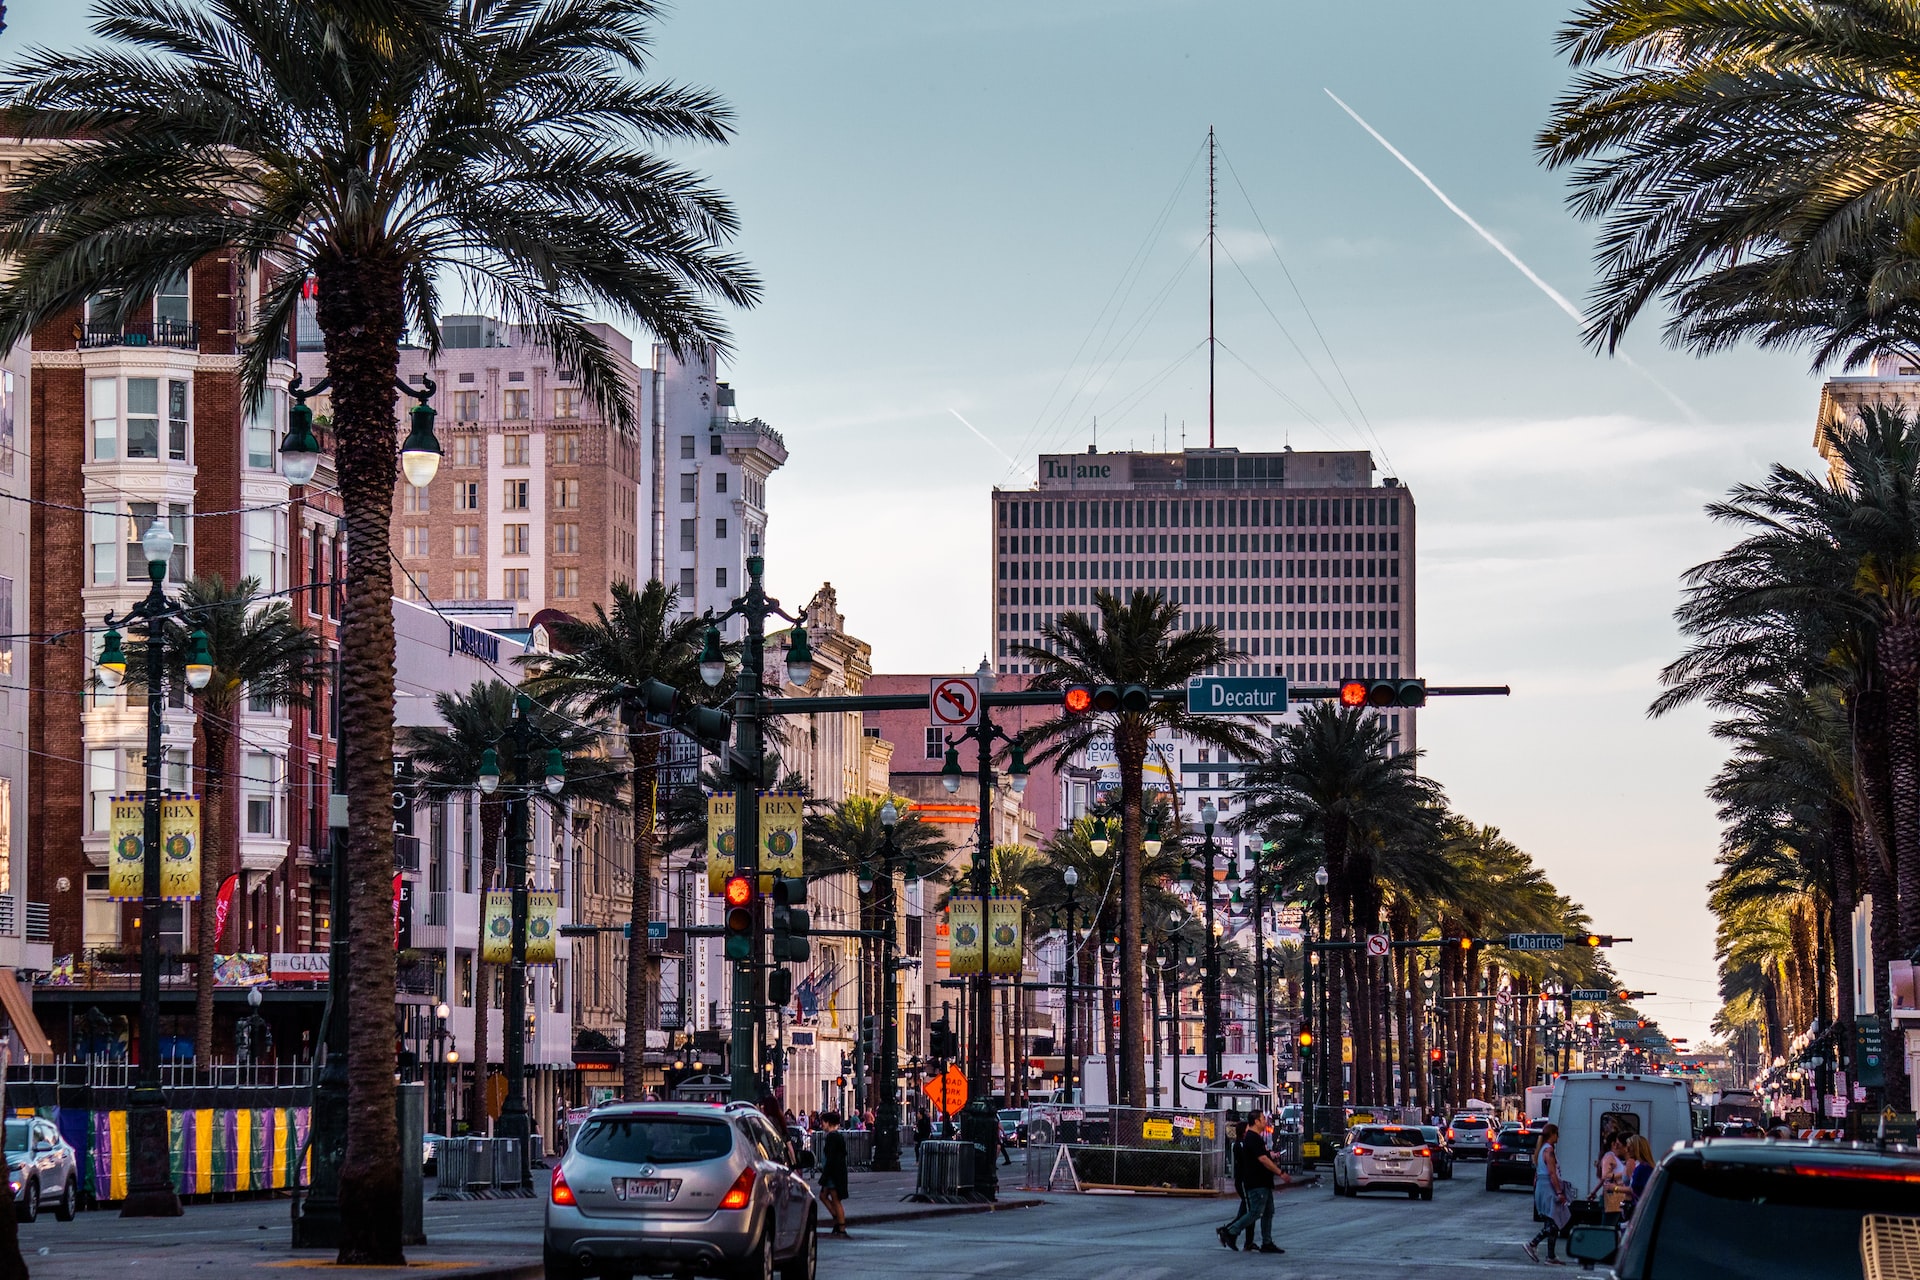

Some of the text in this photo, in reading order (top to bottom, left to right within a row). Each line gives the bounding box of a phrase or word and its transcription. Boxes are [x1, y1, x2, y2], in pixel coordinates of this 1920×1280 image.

[1043, 460, 1111, 478] Tuane
[1211, 684, 1277, 706] Decatur
[163, 805, 194, 818] REX
[714, 802, 735, 815] RE
[765, 801, 797, 815] REX
[1221, 836, 1234, 845] THE
[121, 874, 141, 887] 150
[169, 873, 189, 886] 150
[529, 896, 553, 906] REX
[953, 903, 978, 914] REX
[993, 903, 1017, 914] REX
[1517, 935, 1562, 949] Chartres
[274, 955, 330, 971] THE GIAN
[1579, 991, 1602, 1000] Royal
[1614, 1020, 1637, 1029] Bourbon
[945, 1078, 962, 1086] OAD
[940, 1088, 961, 1096] ORK
[935, 1097, 962, 1106] AEAD
[1610, 1102, 1631, 1112] SS-127
